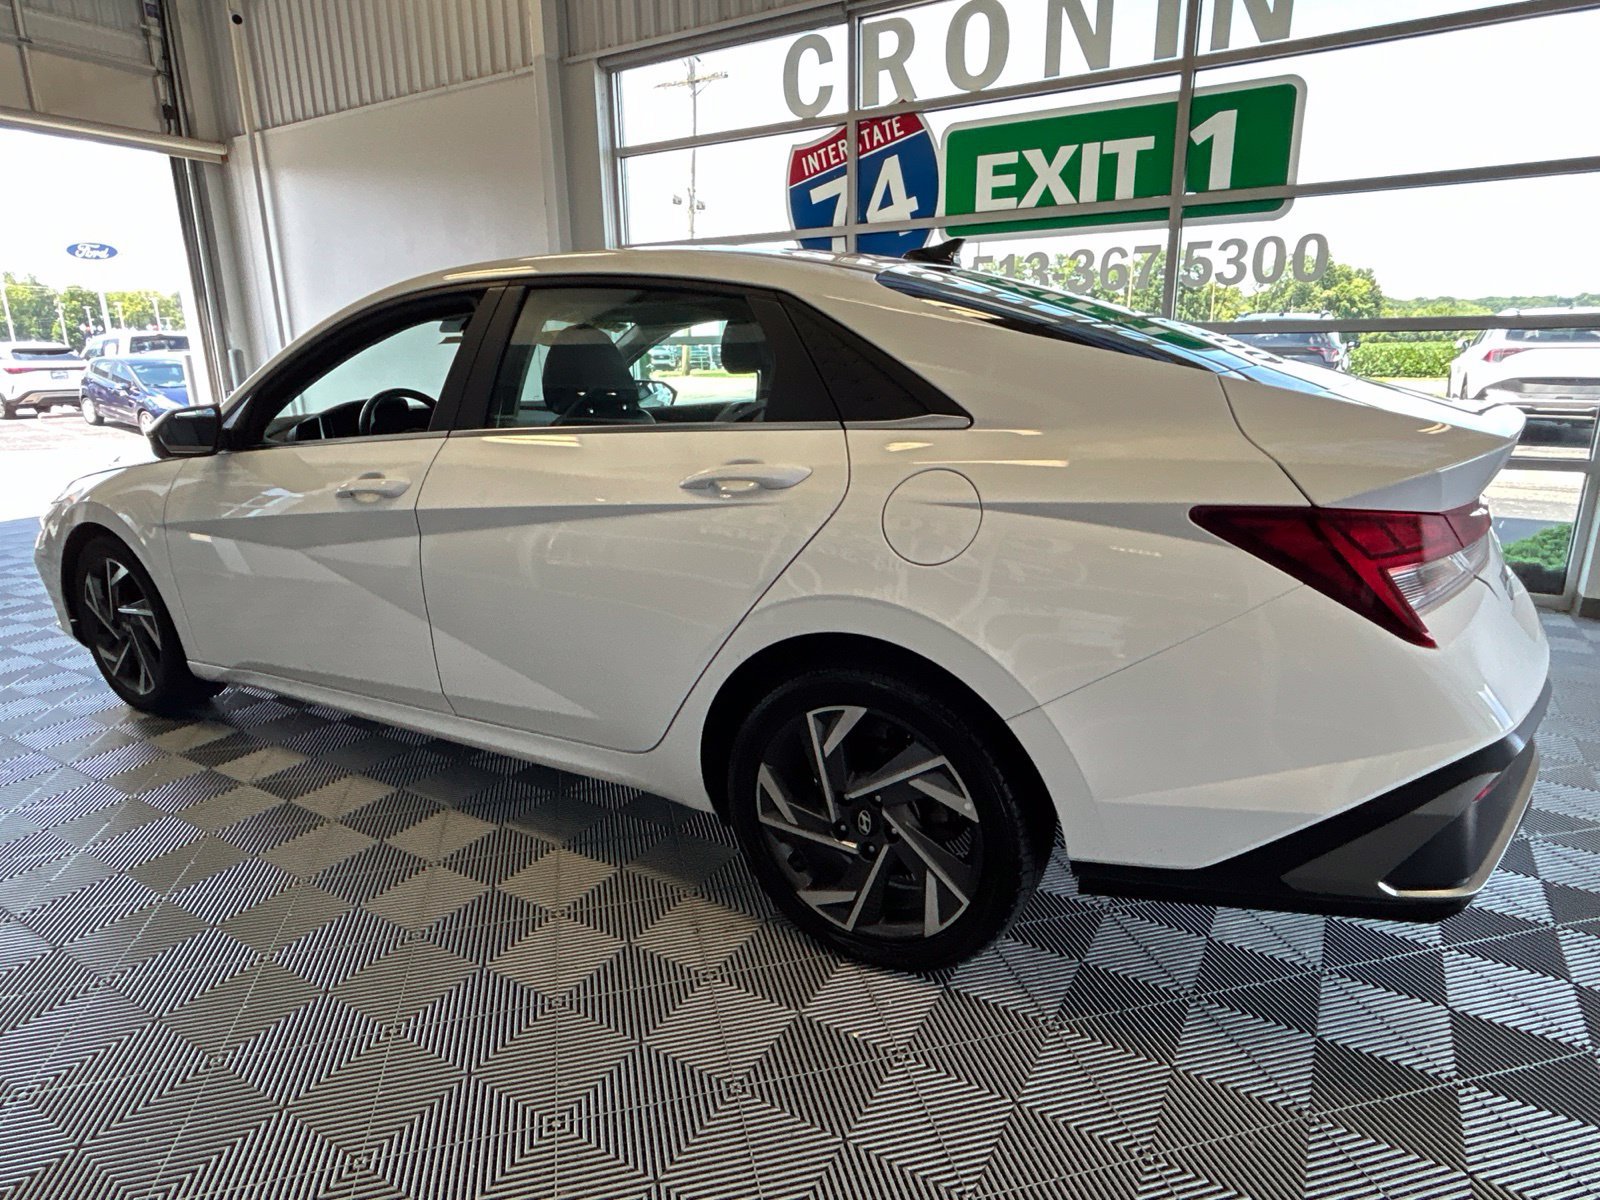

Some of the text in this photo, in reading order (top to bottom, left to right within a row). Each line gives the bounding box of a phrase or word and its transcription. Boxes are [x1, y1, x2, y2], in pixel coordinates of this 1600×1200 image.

[801, 115, 905, 177] INTERTATE
[975, 109, 1238, 212] EXIT 1
[809, 154, 919, 253] 74
[75, 243, 110, 259] Ford
